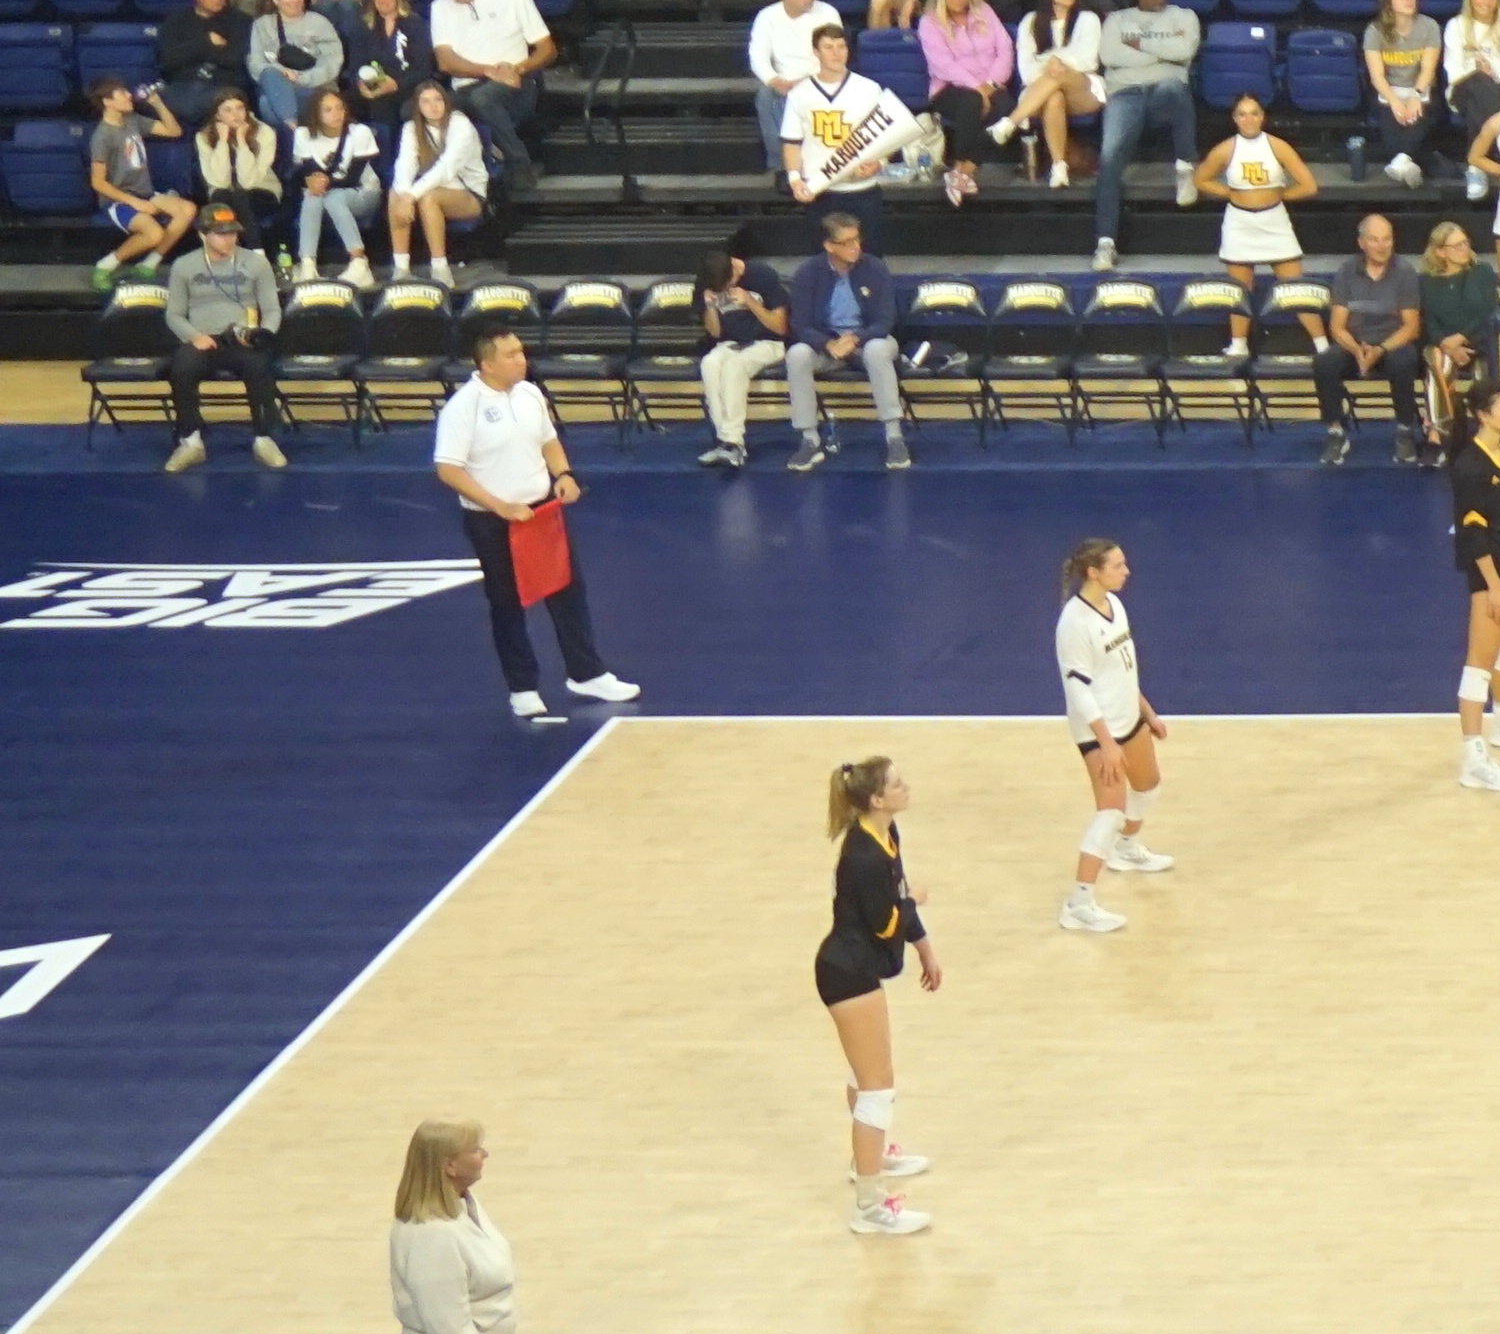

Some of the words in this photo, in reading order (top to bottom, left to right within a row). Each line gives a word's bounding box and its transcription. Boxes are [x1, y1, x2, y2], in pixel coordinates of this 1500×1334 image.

[812, 110, 853, 148] MU
[821, 103, 894, 180] MARQUETTE
[1241, 162, 1270, 186] MU
[0, 569, 485, 599] EAST
[0, 597, 414, 628] BIG
